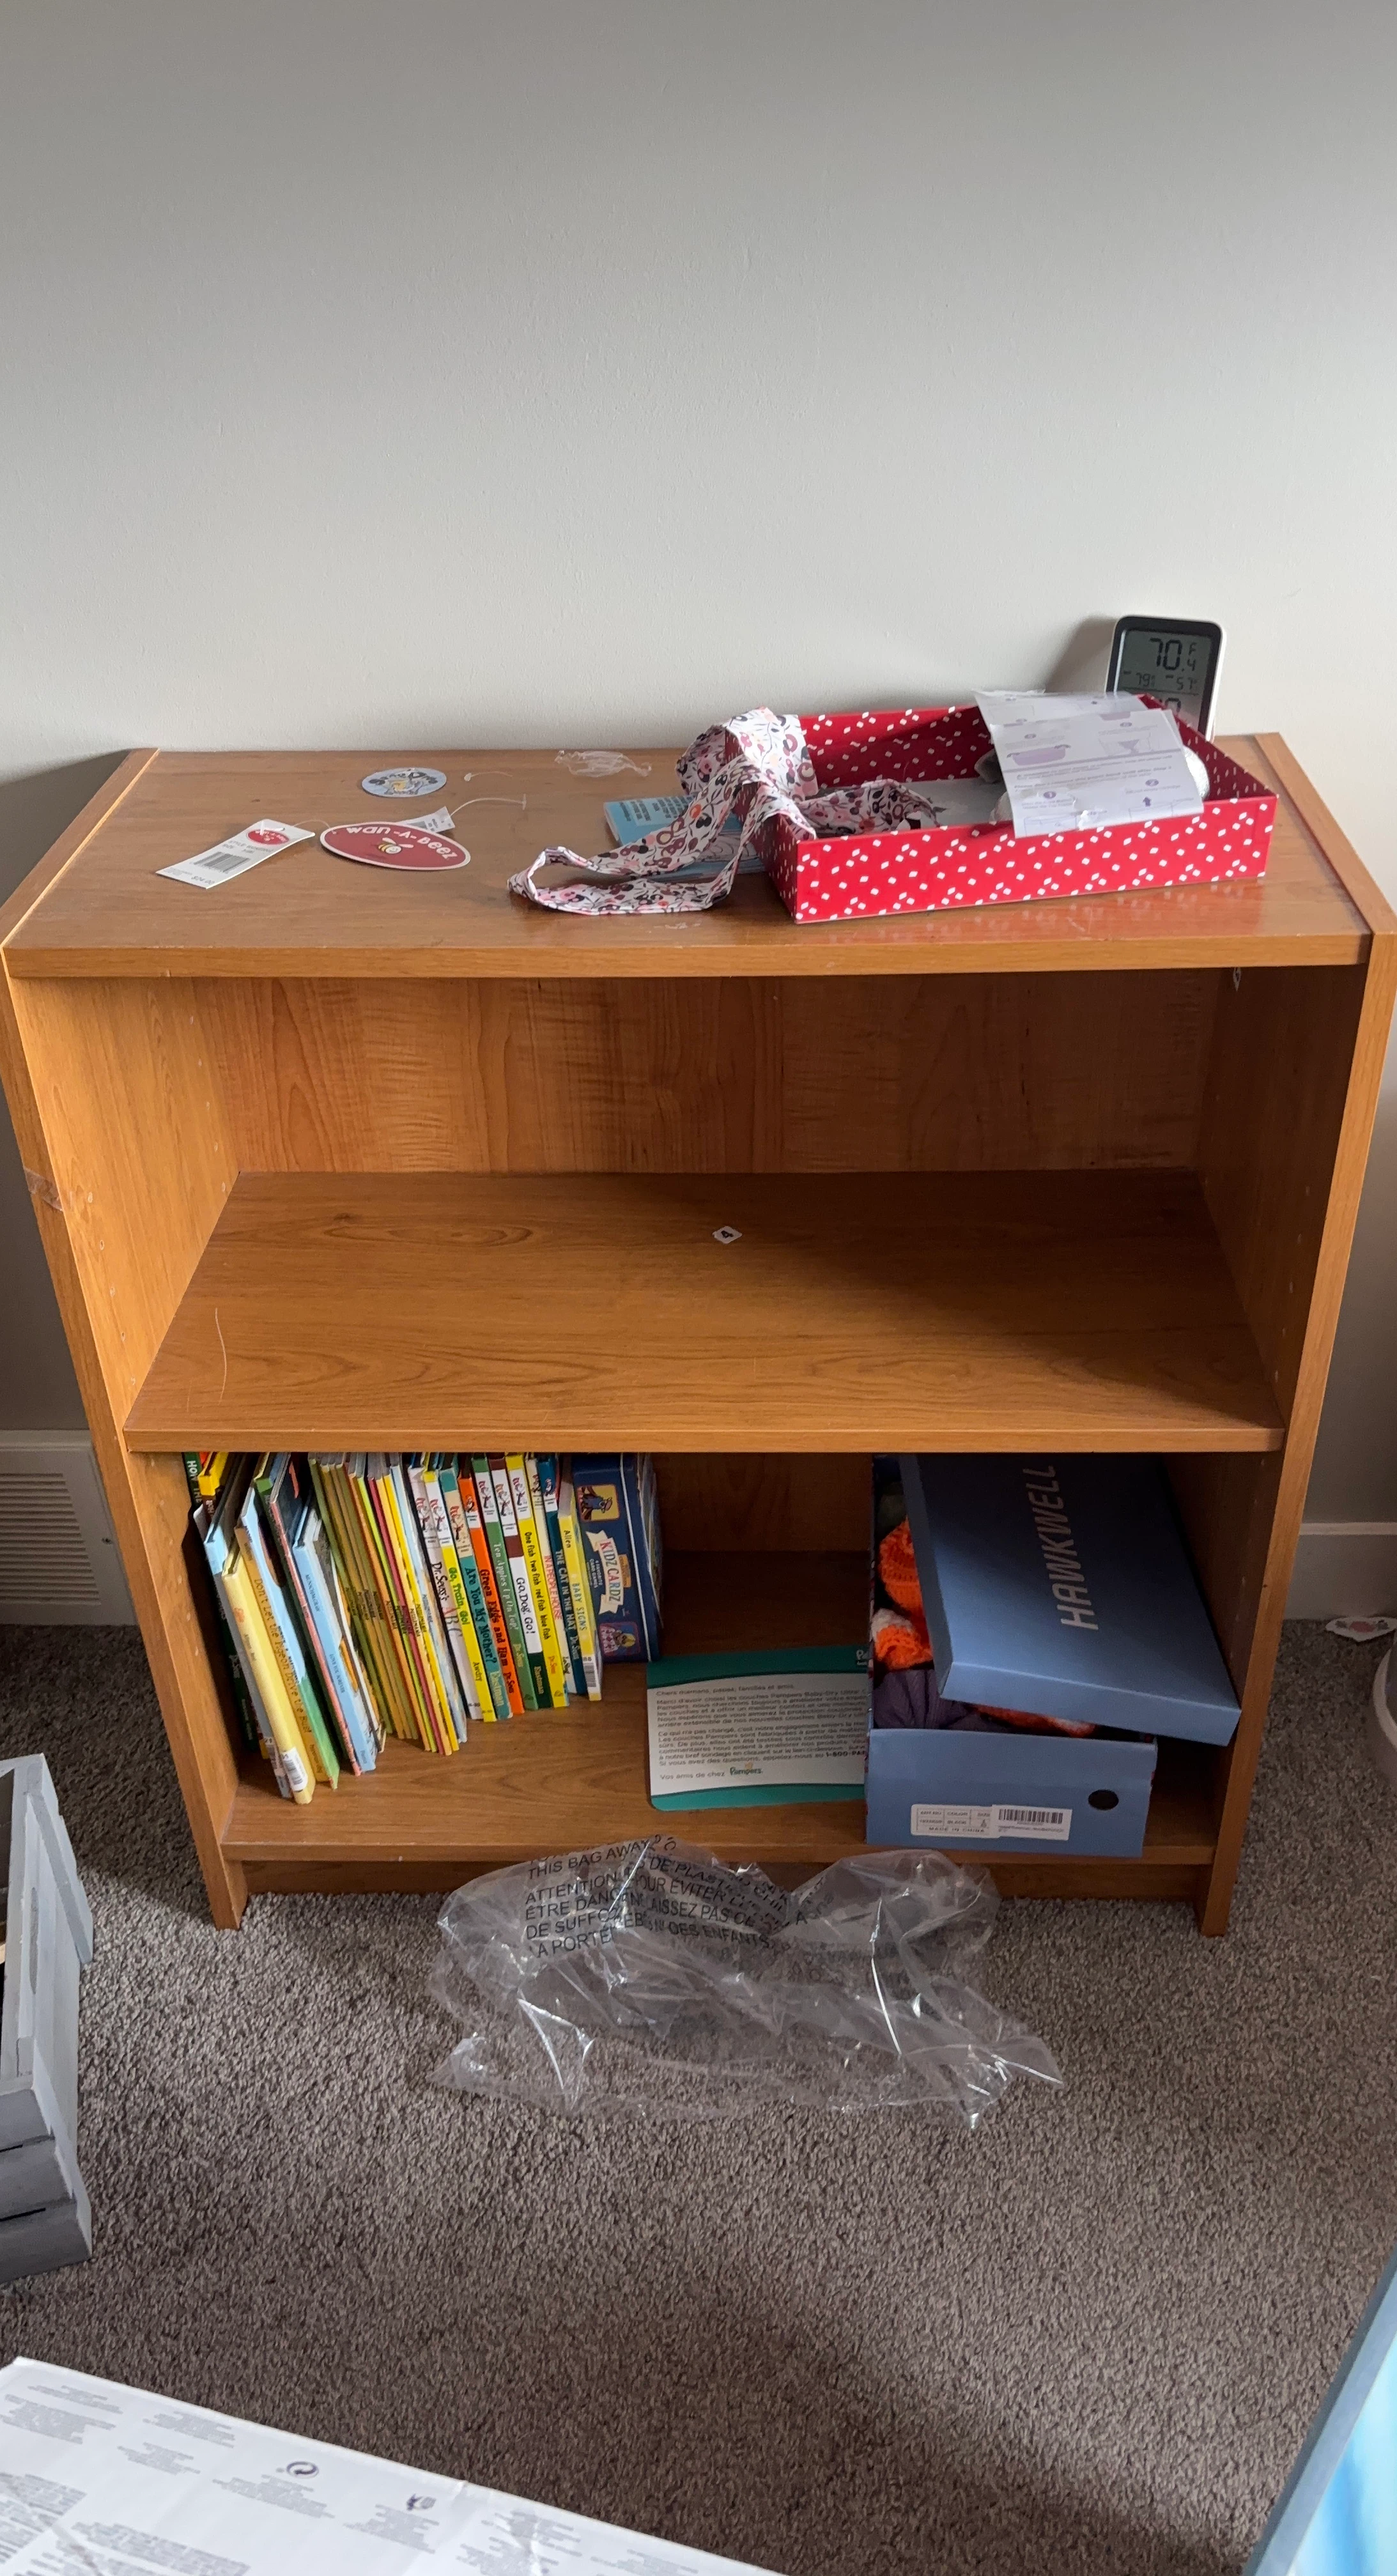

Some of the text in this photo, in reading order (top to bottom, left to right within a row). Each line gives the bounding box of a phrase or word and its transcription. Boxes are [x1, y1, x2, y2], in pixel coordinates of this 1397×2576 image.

[524, 1531, 533, 1545] One
[563, 1529, 573, 1549] Allen
[527, 1544, 536, 1558] fish
[1023, 1465, 1099, 1630] HAWKWELL
[530, 1560, 538, 1572] two
[555, 1549, 565, 1565] THE
[464, 1567, 477, 1586] Are
[532, 1572, 542, 1586] fish
[558, 1568, 569, 1584] CAT
[599, 1540, 621, 1602] KIDZ CARDZ
[254, 1578, 269, 1603] Don't
[480, 1569, 491, 1597] Green
[561, 1584, 570, 1596] IN
[470, 1586, 482, 1606] You
[537, 1598, 546, 1612] fish
[563, 1595, 573, 1612] THE
[261, 1603, 274, 1621] Let
[474, 1607, 487, 1624] My
[487, 1600, 502, 1623] Eggs
[571, 1583, 588, 1632] BABY SIGNS
[459, 1609, 470, 1626] Go!
[523, 1617, 536, 1634] Go!
[540, 1614, 548, 1629] blue
[566, 1613, 577, 1630] HAT
[268, 1623, 280, 1638] the
[493, 1625, 506, 1644] and
[543, 1627, 552, 1641] fish
[480, 1623, 498, 1664] Mother?
[274, 1638, 290, 1669] Pigeon
[497, 1646, 509, 1667] Ham
[285, 1671, 299, 1698] Drive
[490, 1669, 505, 1708] Eastman
[534, 1665, 544, 1695] Eastman
[293, 1698, 304, 1713] the
[528, 1860, 562, 1880] THIS
[567, 1851, 601, 1869] BAG
[701, 1904, 729, 1922] PAS
[526, 1922, 549, 1940] DE
